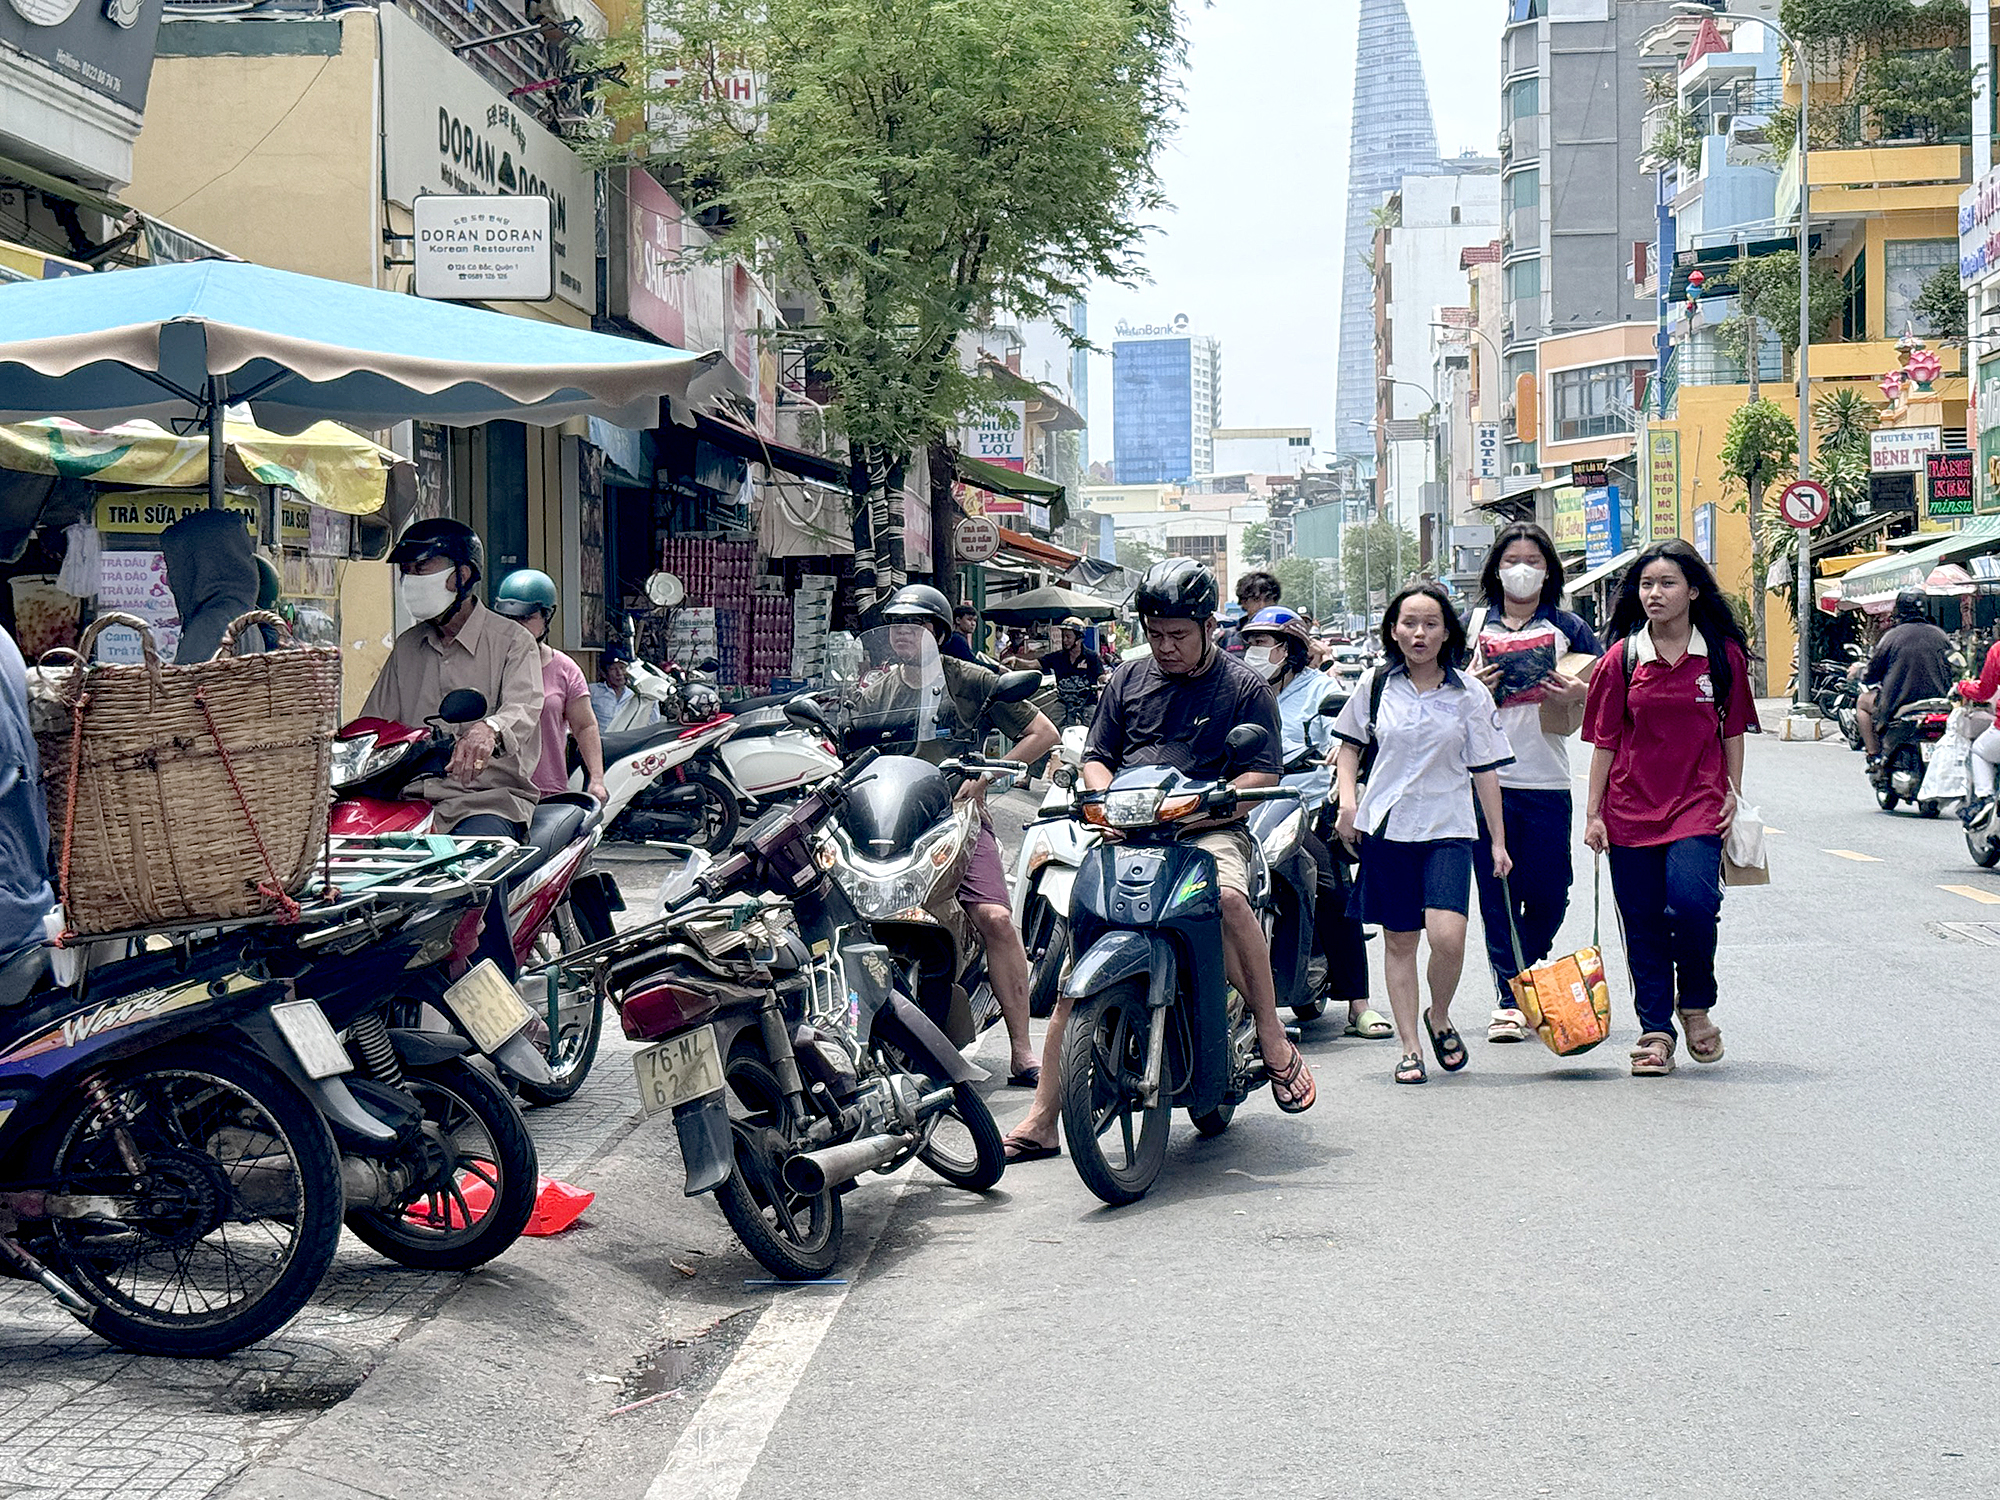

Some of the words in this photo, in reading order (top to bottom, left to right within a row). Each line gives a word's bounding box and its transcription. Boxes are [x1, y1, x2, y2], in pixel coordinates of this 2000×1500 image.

[439, 106, 496, 188] DORAN
[421, 229, 479, 242] DORAN
[486, 229, 543, 242] DORAN
[429, 244, 469, 253] Korean
[473, 244, 535, 253] Restaurant
[1114, 323, 1174, 337] VietinBank
[1873, 432, 1914, 443] CHUYÊN
[1917, 431, 1935, 441] TRỊ
[981, 443, 1012, 456] LỢI
[1480, 430, 1496, 476] HOTEL
[1873, 446, 1909, 469] BỆNH
[1934, 480, 1971, 497] KEM
[1929, 499, 1973, 513] minsu
[109, 503, 139, 523] TRÀ
[144, 503, 177, 524] SỮA
[101, 556, 122, 568] TRÀ
[101, 571, 122, 581] TRÀ
[101, 585, 123, 595] TRÀ
[105, 632, 132, 642] Cam
[107, 646, 128, 656] Trà
[117, 987, 157, 1004] HONDA
[59, 987, 188, 1048] Wave
